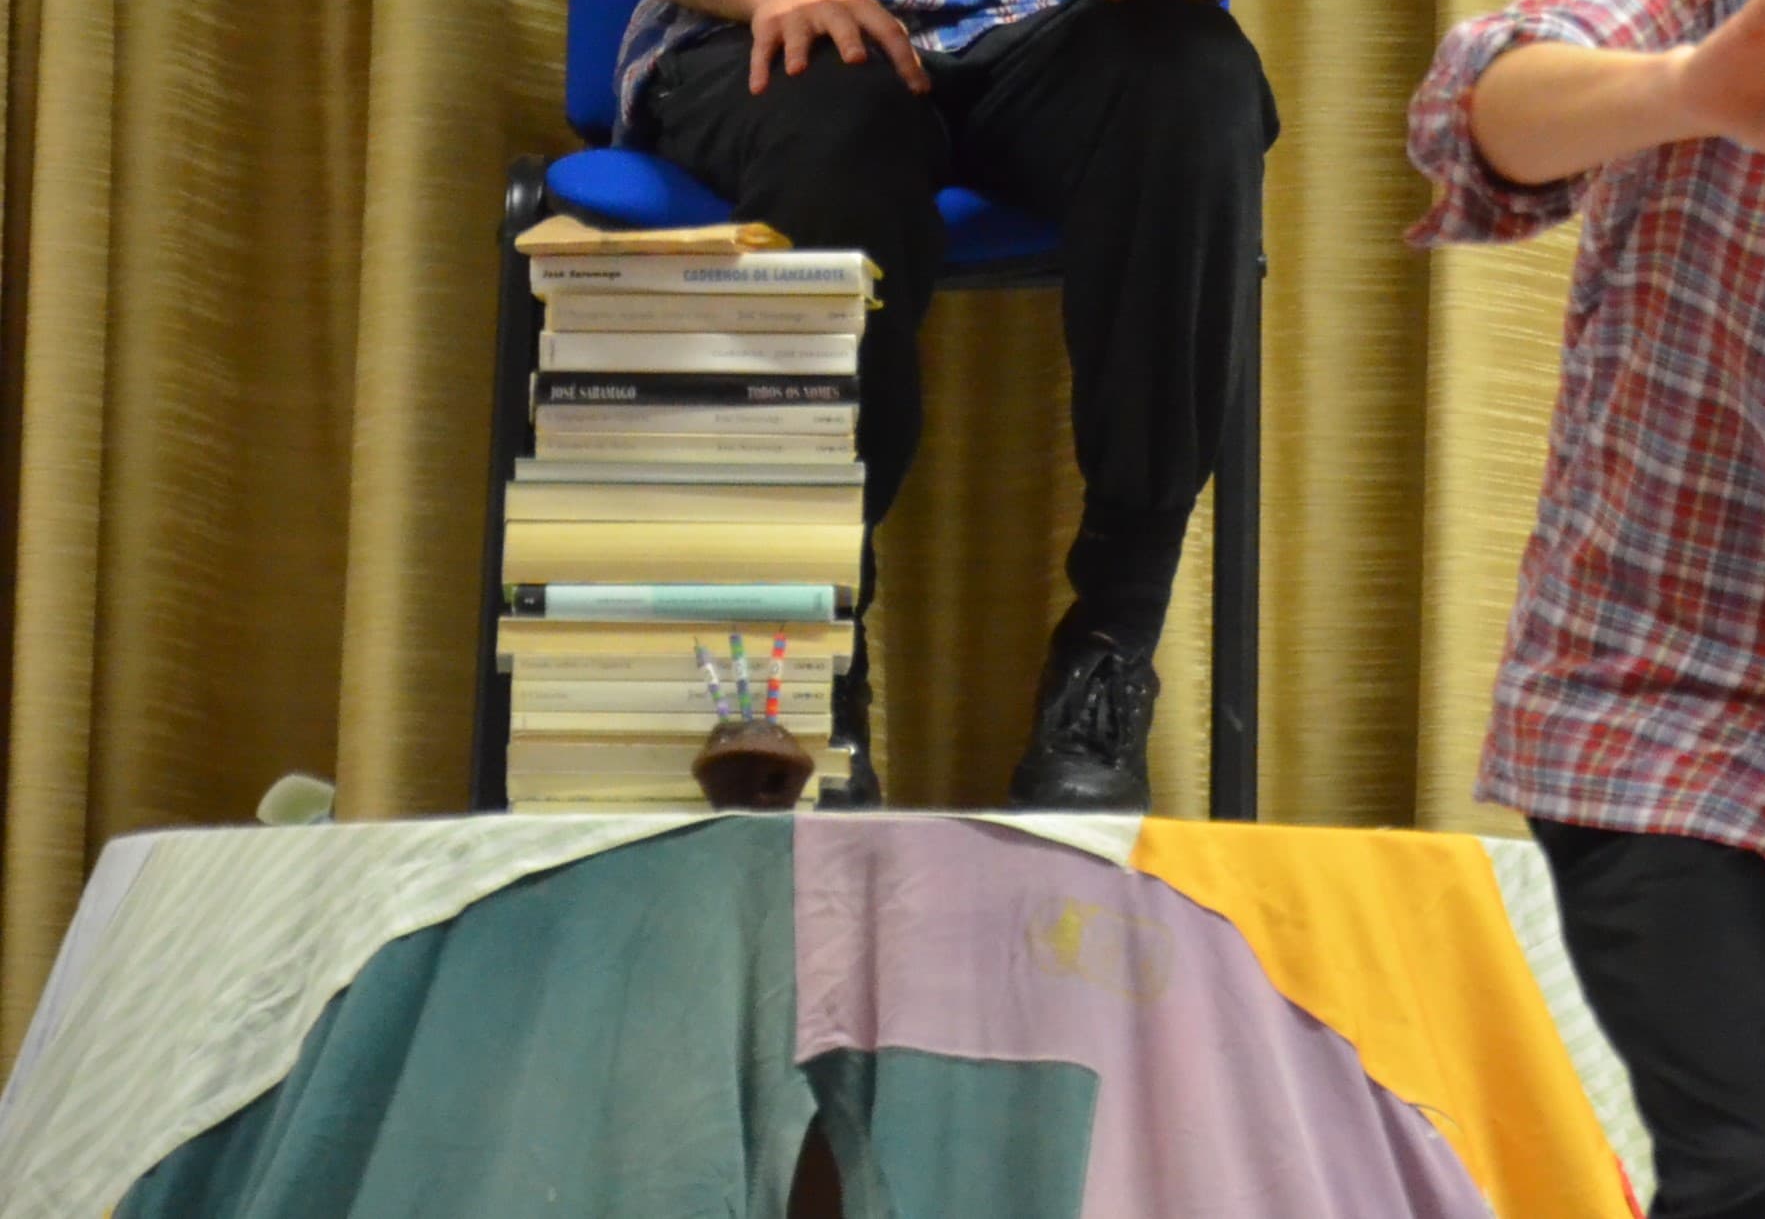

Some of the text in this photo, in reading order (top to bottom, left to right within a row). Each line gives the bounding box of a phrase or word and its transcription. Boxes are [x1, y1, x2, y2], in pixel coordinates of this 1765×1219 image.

[683, 268, 845, 283] CADERNOS DE LANZAROTE
[551, 384, 637, 400] JOSÉ SARAMAGO
[747, 386, 841, 399] TODOS OS NOMES
